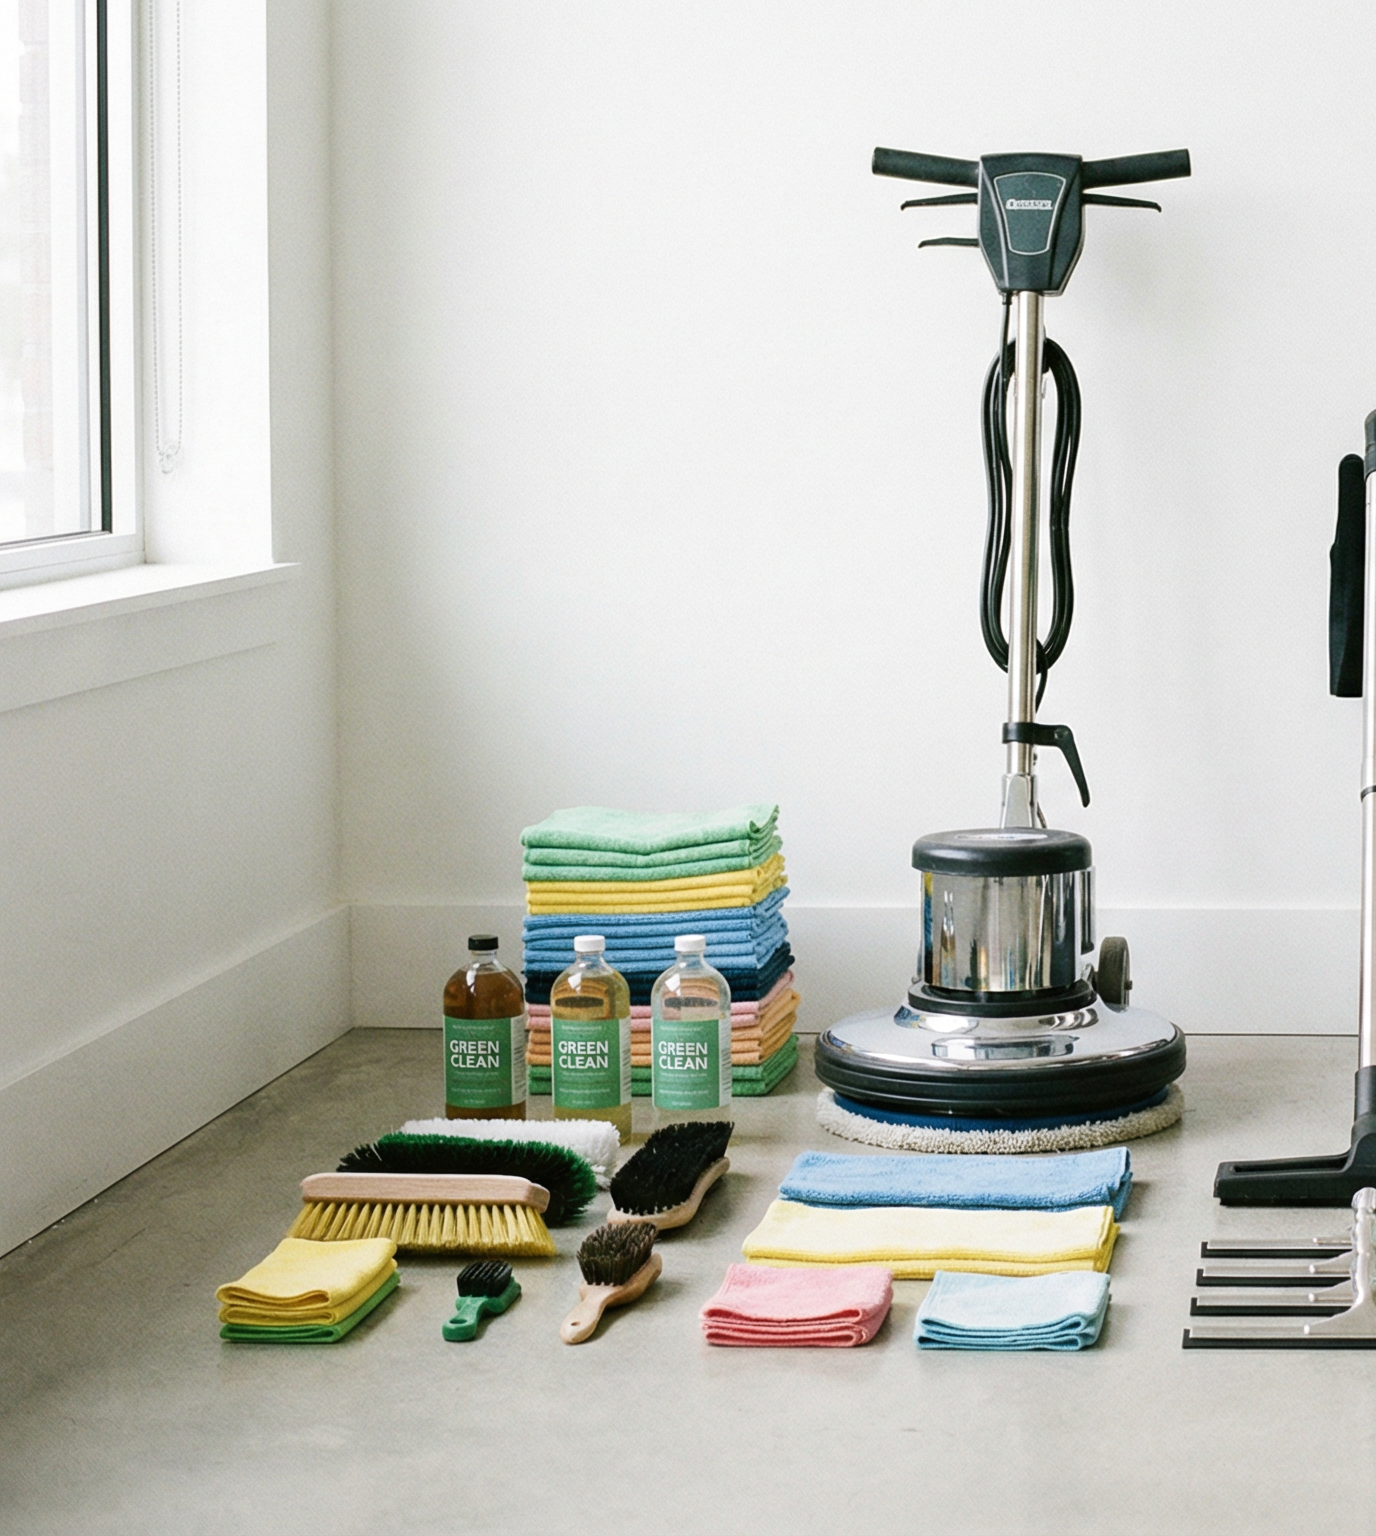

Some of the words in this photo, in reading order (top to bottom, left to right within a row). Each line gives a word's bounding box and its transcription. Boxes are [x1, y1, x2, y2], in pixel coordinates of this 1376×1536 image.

[449, 1039, 500, 1054] GREEN
[558, 1040, 609, 1054] GREEN
[658, 1041, 708, 1056] GREEN
[450, 1054, 500, 1068] CLEAN
[559, 1055, 609, 1069] CLEAN
[658, 1055, 708, 1070] CLEAN
